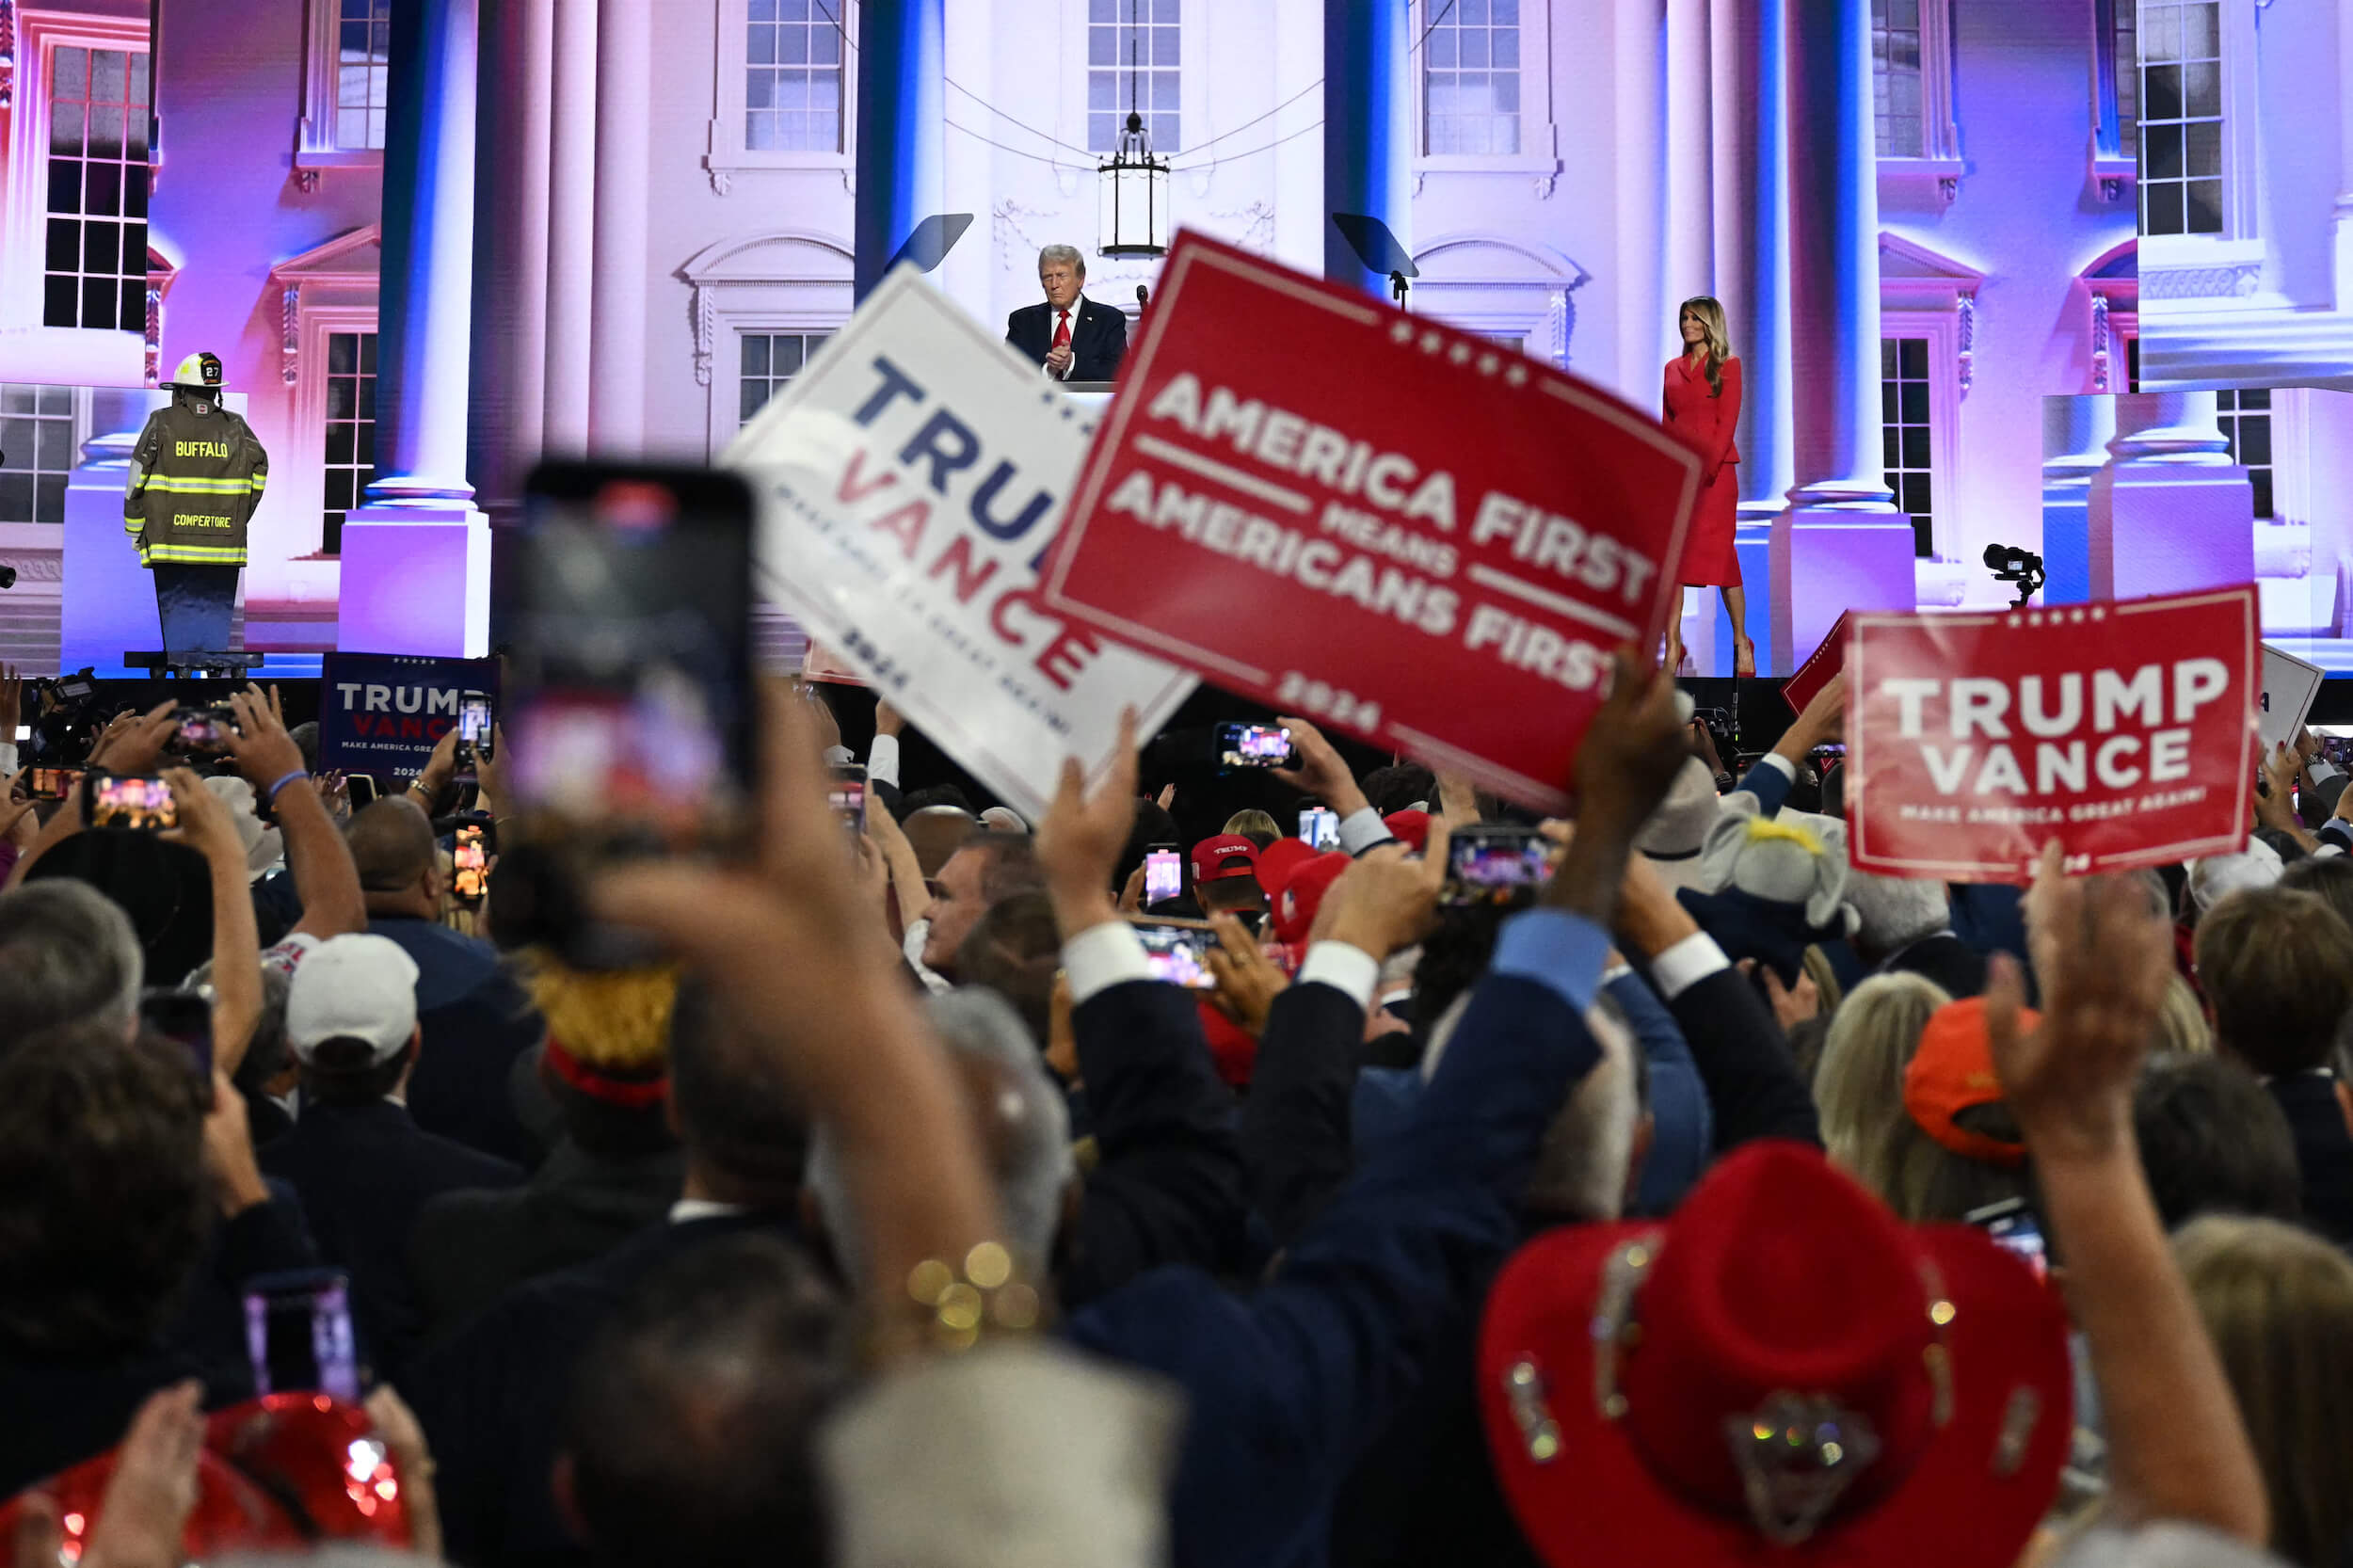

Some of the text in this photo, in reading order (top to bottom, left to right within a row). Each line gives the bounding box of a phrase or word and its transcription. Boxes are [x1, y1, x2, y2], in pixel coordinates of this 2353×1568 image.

[206, 367, 218, 377] 27
[175, 440, 229, 458] BUFFALO
[853, 355, 1055, 571] TRU
[1147, 371, 1659, 605] AMERICA FIRST
[173, 514, 232, 529] COMPERTORE
[1319, 501, 1459, 579] MEANS
[834, 447, 1103, 692] VANCE
[1105, 469, 1461, 636] AMERICANS
[337, 682, 485, 716] TRUM
[1273, 671, 1384, 733] 2024
[1879, 657, 2231, 742] TRUMP
[342, 741, 437, 754] MAKE AMERICA GREA
[353, 714, 458, 741] VANC
[1919, 726, 2193, 796] VANCE
[1898, 785, 2207, 825] MAKE AMERICA GREAT AGAIN!
[1213, 845, 1249, 855] TRUMP
